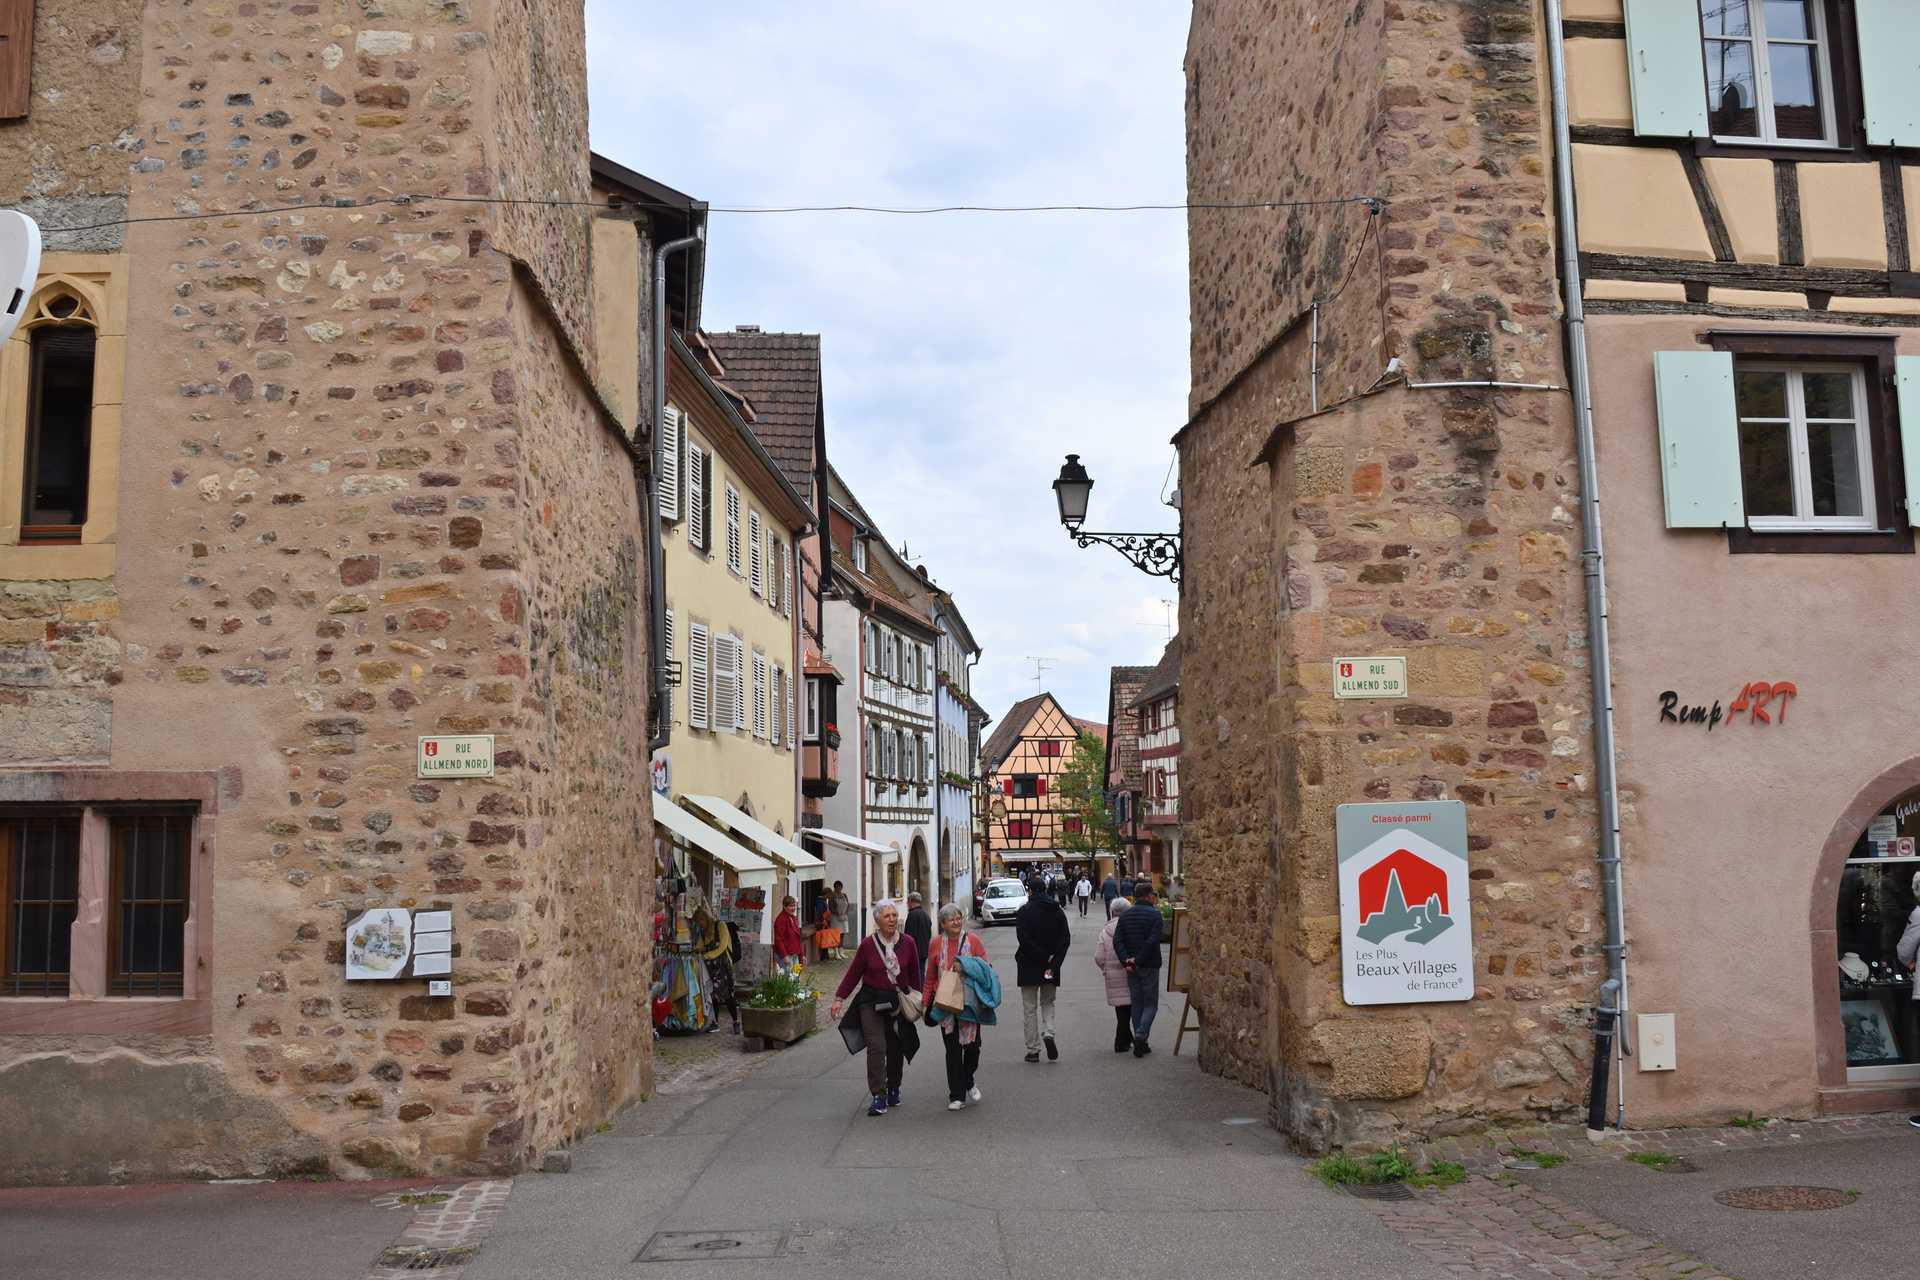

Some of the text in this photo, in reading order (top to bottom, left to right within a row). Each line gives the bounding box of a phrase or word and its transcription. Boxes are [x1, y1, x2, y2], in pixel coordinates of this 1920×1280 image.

[1370, 664, 1385, 675] RUE
[1342, 680, 1399, 691] ALLMEND SUD
[455, 743, 472, 753] RUE
[423, 759, 488, 770] ALLMEND NORD
[1405, 812, 1432, 824] parmi
[1356, 949, 1399, 960] Les Plus
[1357, 960, 1458, 977] Beaux Villages
[1407, 980, 1421, 991] de
